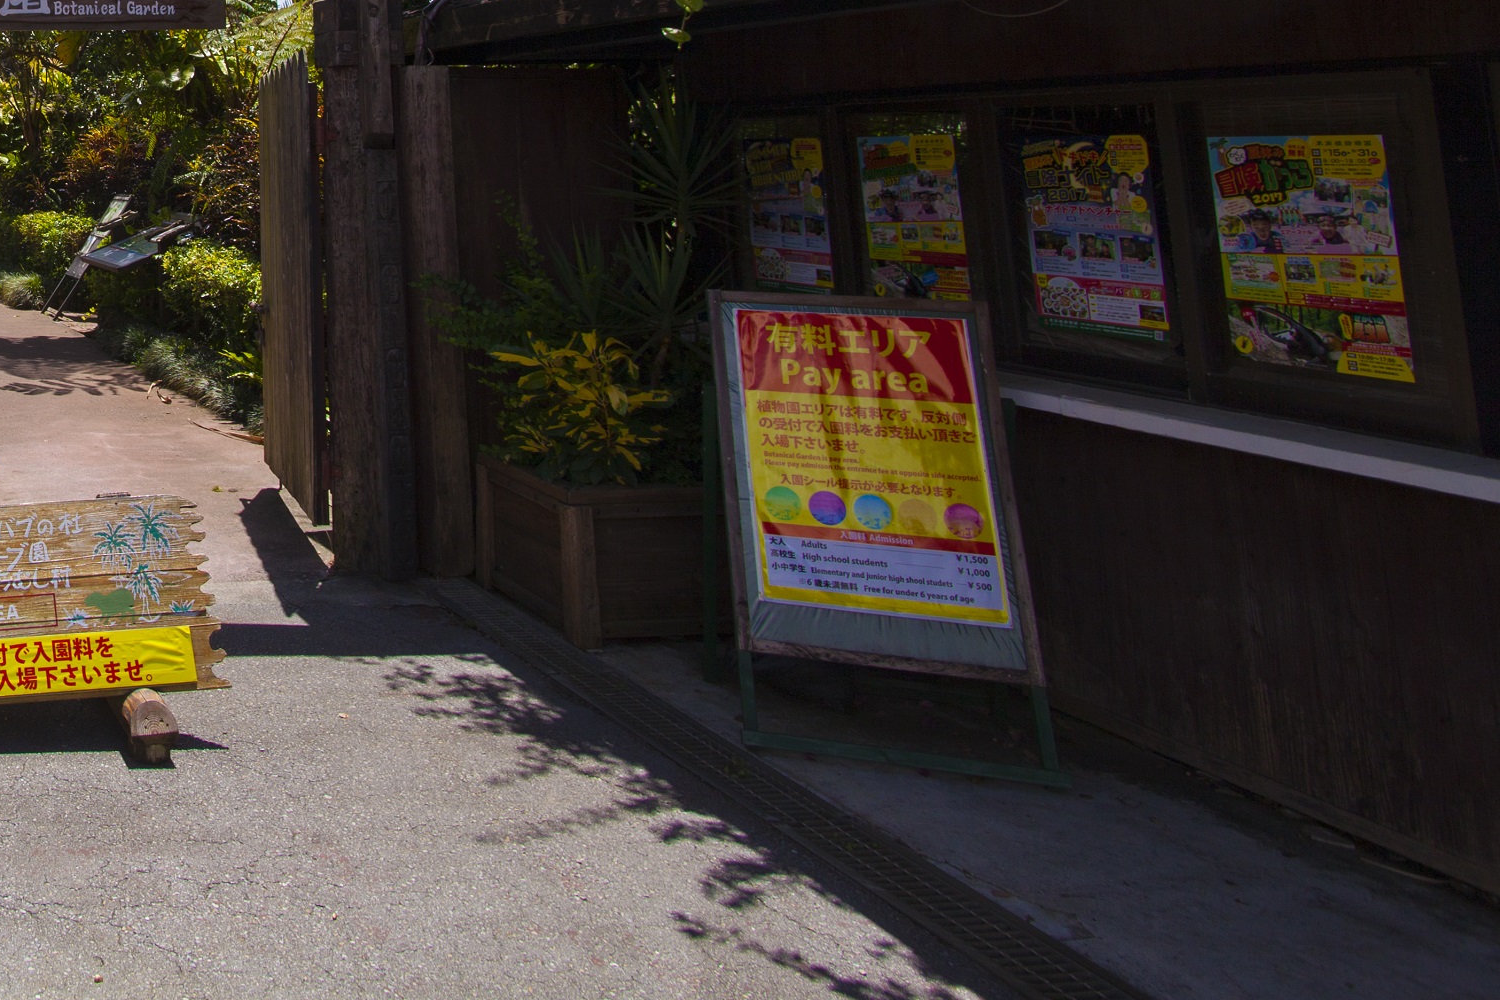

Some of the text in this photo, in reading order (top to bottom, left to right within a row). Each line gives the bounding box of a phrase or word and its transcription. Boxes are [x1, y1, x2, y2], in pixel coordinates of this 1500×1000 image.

[53, 0, 176, 16] Botanical Garden
[1024, 164, 1111, 189] 冒険ナイト
[1047, 188, 1086, 204] 2017
[1252, 191, 1284, 205] 2017
[765, 323, 932, 359] 有料エリア
[780, 358, 929, 395] Pay area
[761, 433, 865, 454] 入場下さいませ。
[764, 450, 795, 459] Botanical
[796, 453, 821, 461] Garden
[829, 456, 841, 464] pay
[764, 458, 786, 466] Please
[787, 461, 799, 469] pay
[833, 463, 845, 471] the
[847, 465, 877, 474] entrance
[899, 469, 929, 479] opposite
[781, 473, 963, 500] 入園シール提示が必要となります。
[769, 536, 786, 546] 大人
[801, 540, 828, 549] Adults
[869, 534, 914, 546] Admission
[771, 548, 796, 560] 高校生
[802, 552, 822, 562] High
[823, 555, 850, 565] school
[851, 558, 888, 568] students
[771, 561, 807, 574] 小中学生
[811, 567, 850, 579] Elementary
[851, 571, 865, 579] and
[865, 572, 887, 581] junior
[888, 574, 904, 584] high
[905, 577, 926, 585] shool
[863, 585, 881, 593] Free
[882, 586, 893, 595] for
[895, 589, 918, 597] under
[927, 592, 948, 601] years
[960, 596, 975, 604] age
